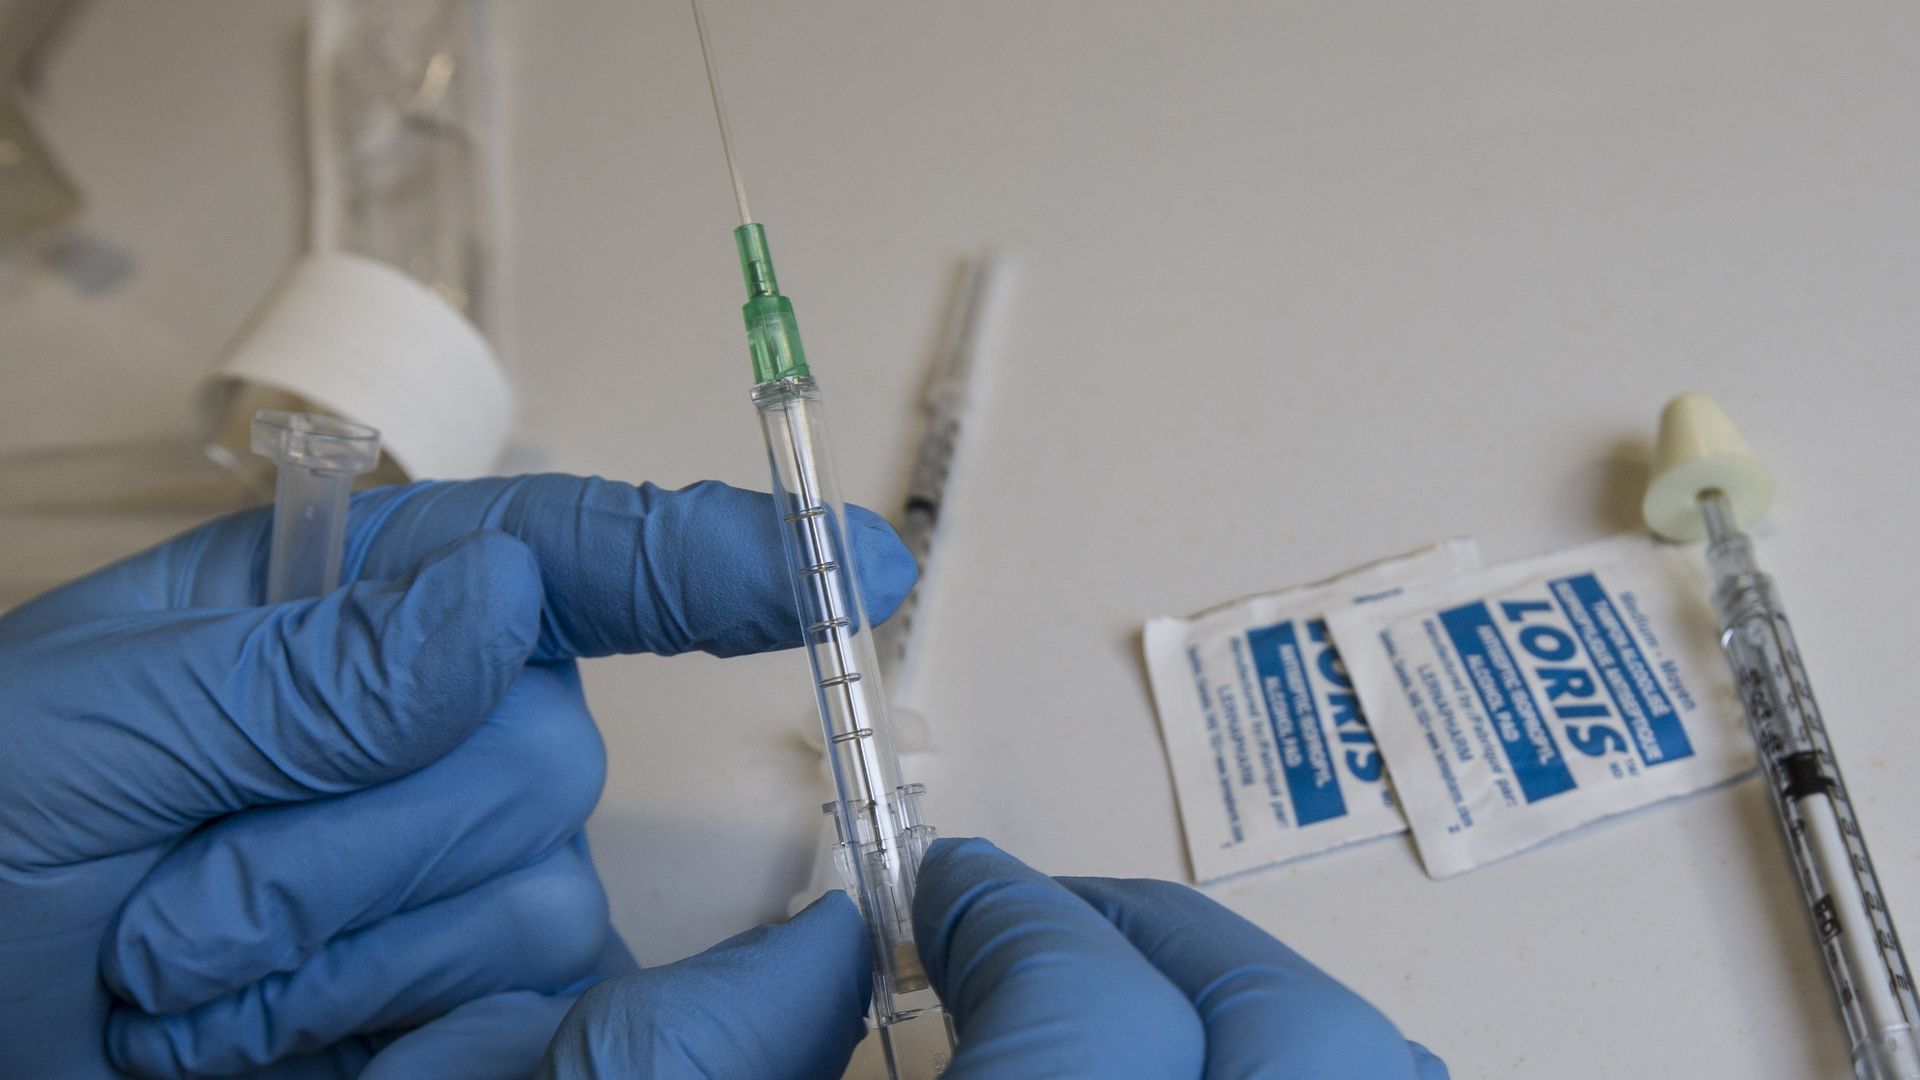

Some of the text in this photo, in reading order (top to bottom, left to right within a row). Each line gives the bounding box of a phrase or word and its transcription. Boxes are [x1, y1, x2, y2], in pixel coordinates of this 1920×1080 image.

[1466, 654, 1520, 742] ALCOHOL PAD
[1476, 625, 1555, 764] ANTISEPTIC ISOPROPYL
[1499, 598, 1629, 760] LORIS
[1555, 581, 1661, 761] ISOPROPYLIQUE ANTISEPTIQUE
[1592, 600, 1670, 717] TAMPON ALCOOLISÉ
[1620, 593, 1659, 647] Medium
[1658, 661, 1697, 711] Moyen
[1216, 686, 1253, 786] LERNAPHARM
[1264, 676, 1301, 767] ALCOHOL PAD
[1278, 644, 1327, 788] ANTISEPTIC ISOPROPYL
[1416, 664, 1472, 763] LERNAPHARM
